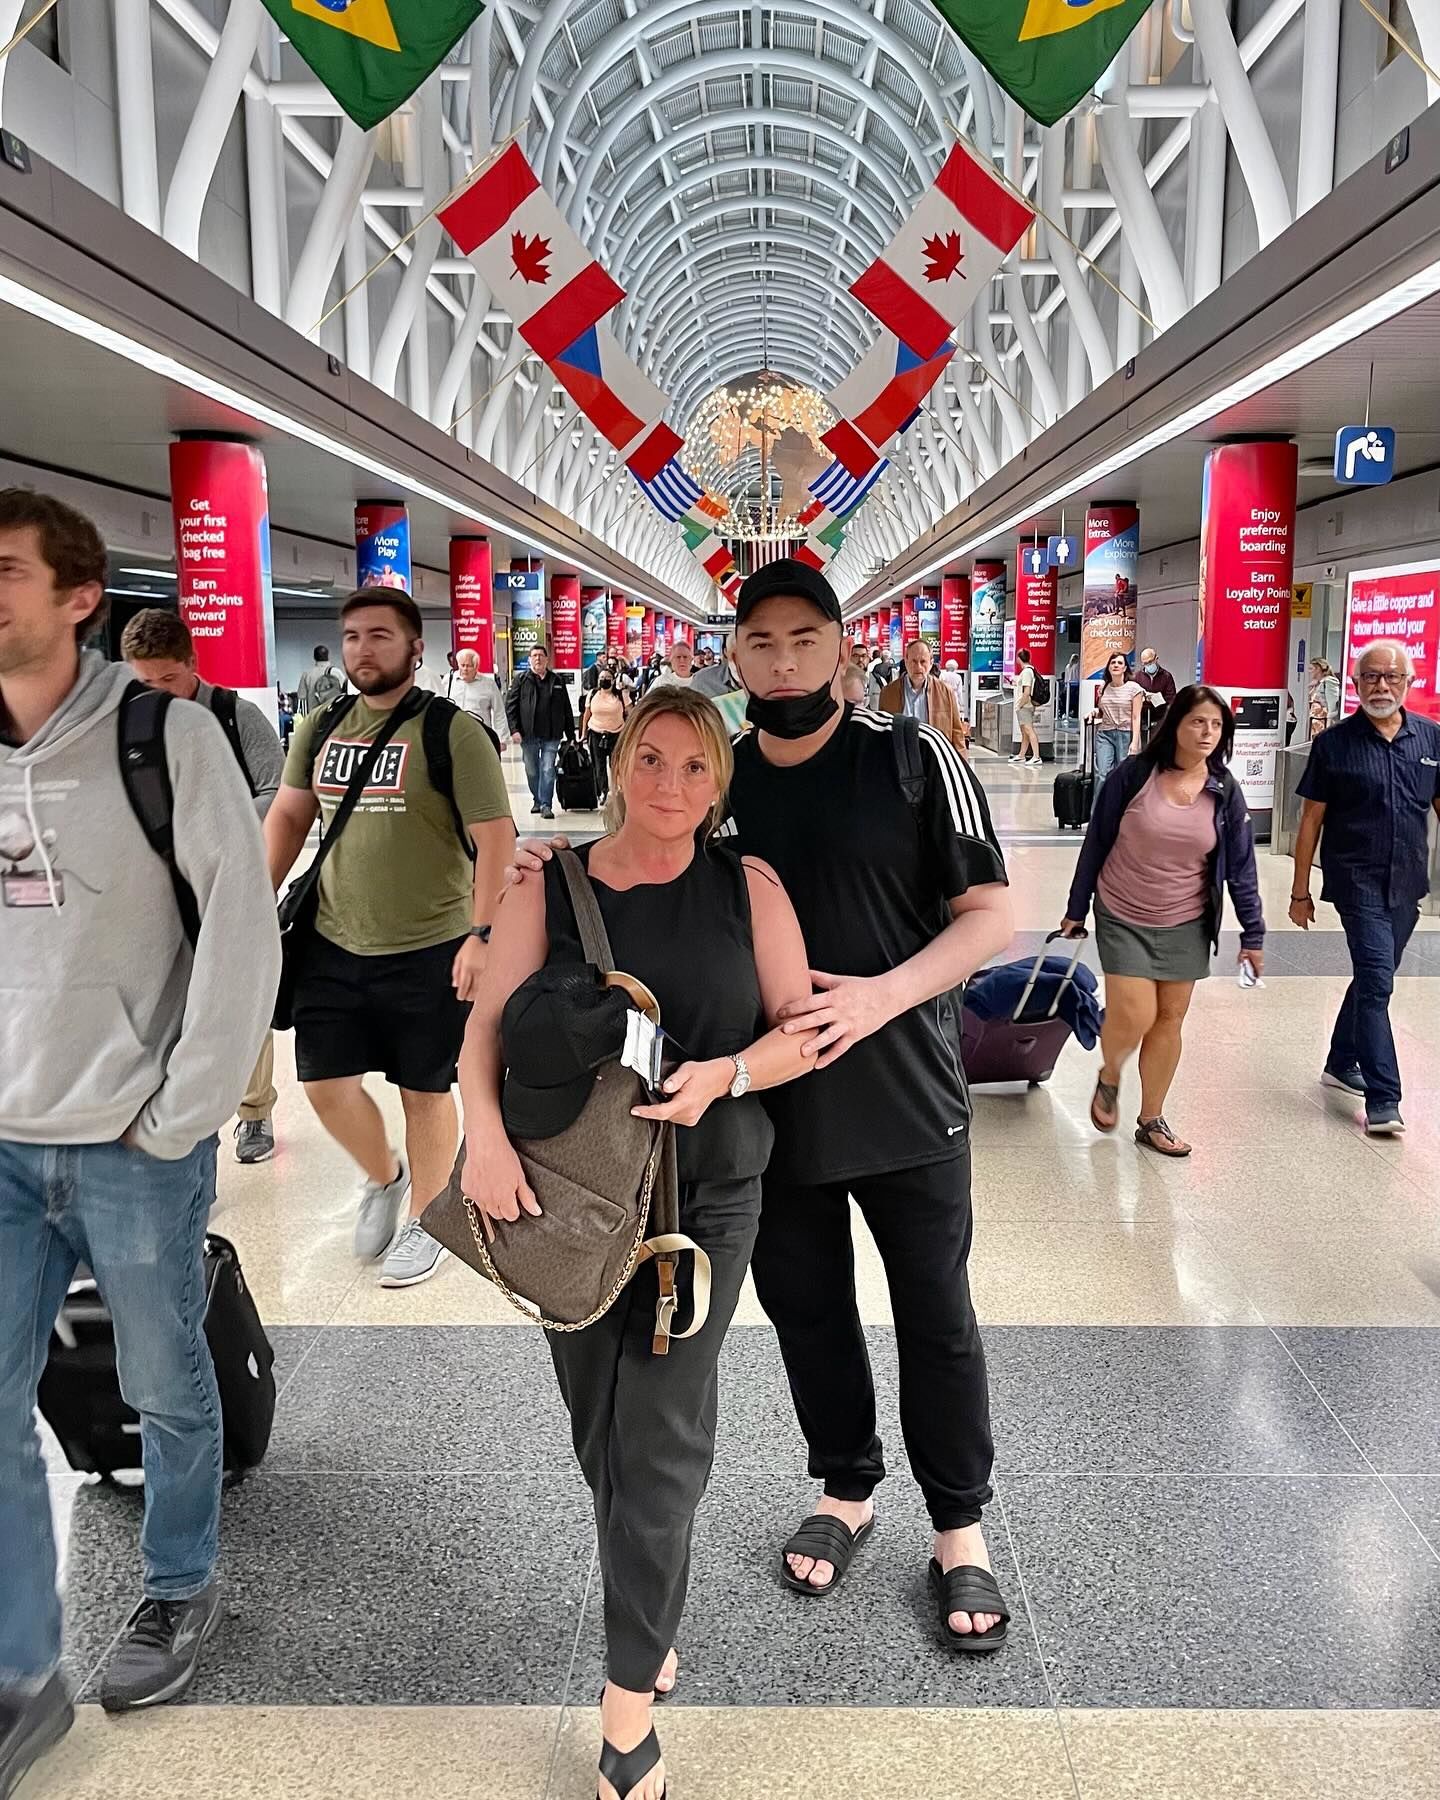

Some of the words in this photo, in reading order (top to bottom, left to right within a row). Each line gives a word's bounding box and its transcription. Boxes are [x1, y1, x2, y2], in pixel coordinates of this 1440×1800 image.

[190, 499, 210, 511] Get
[1251, 508, 1280, 523] Enjoy
[180, 517, 201, 530] your
[204, 514, 227, 527] first
[1089, 519, 1109, 528] More
[182, 531, 224, 542] checked
[1240, 524, 1287, 538] preferred
[374, 536, 399, 546] More
[1113, 539, 1134, 548] More
[1240, 540, 1286, 555] boarding
[183, 547, 201, 561] bag
[203, 546, 225, 558] free
[508, 576, 526, 588] K2
[1251, 572, 1275, 582] Earn
[193, 579, 217, 589] Earn
[209, 594, 243, 605] Points
[1226, 587, 1264, 601] Loyalty
[924, 600, 936, 609] H3
[1352, 597, 1367, 613] Give
[1368, 599, 1373, 611] a
[1390, 596, 1417, 613] copper
[1418, 590, 1434, 608] and
[1242, 603, 1280, 613] toward
[189, 609, 226, 620] toward
[1104, 618, 1123, 629] your
[1354, 620, 1372, 636] show
[1373, 619, 1384, 634] the
[1385, 618, 1407, 634] world
[1407, 620, 1425, 638] your
[1090, 628, 1122, 637] checked
[1105, 639, 1122, 648] free
